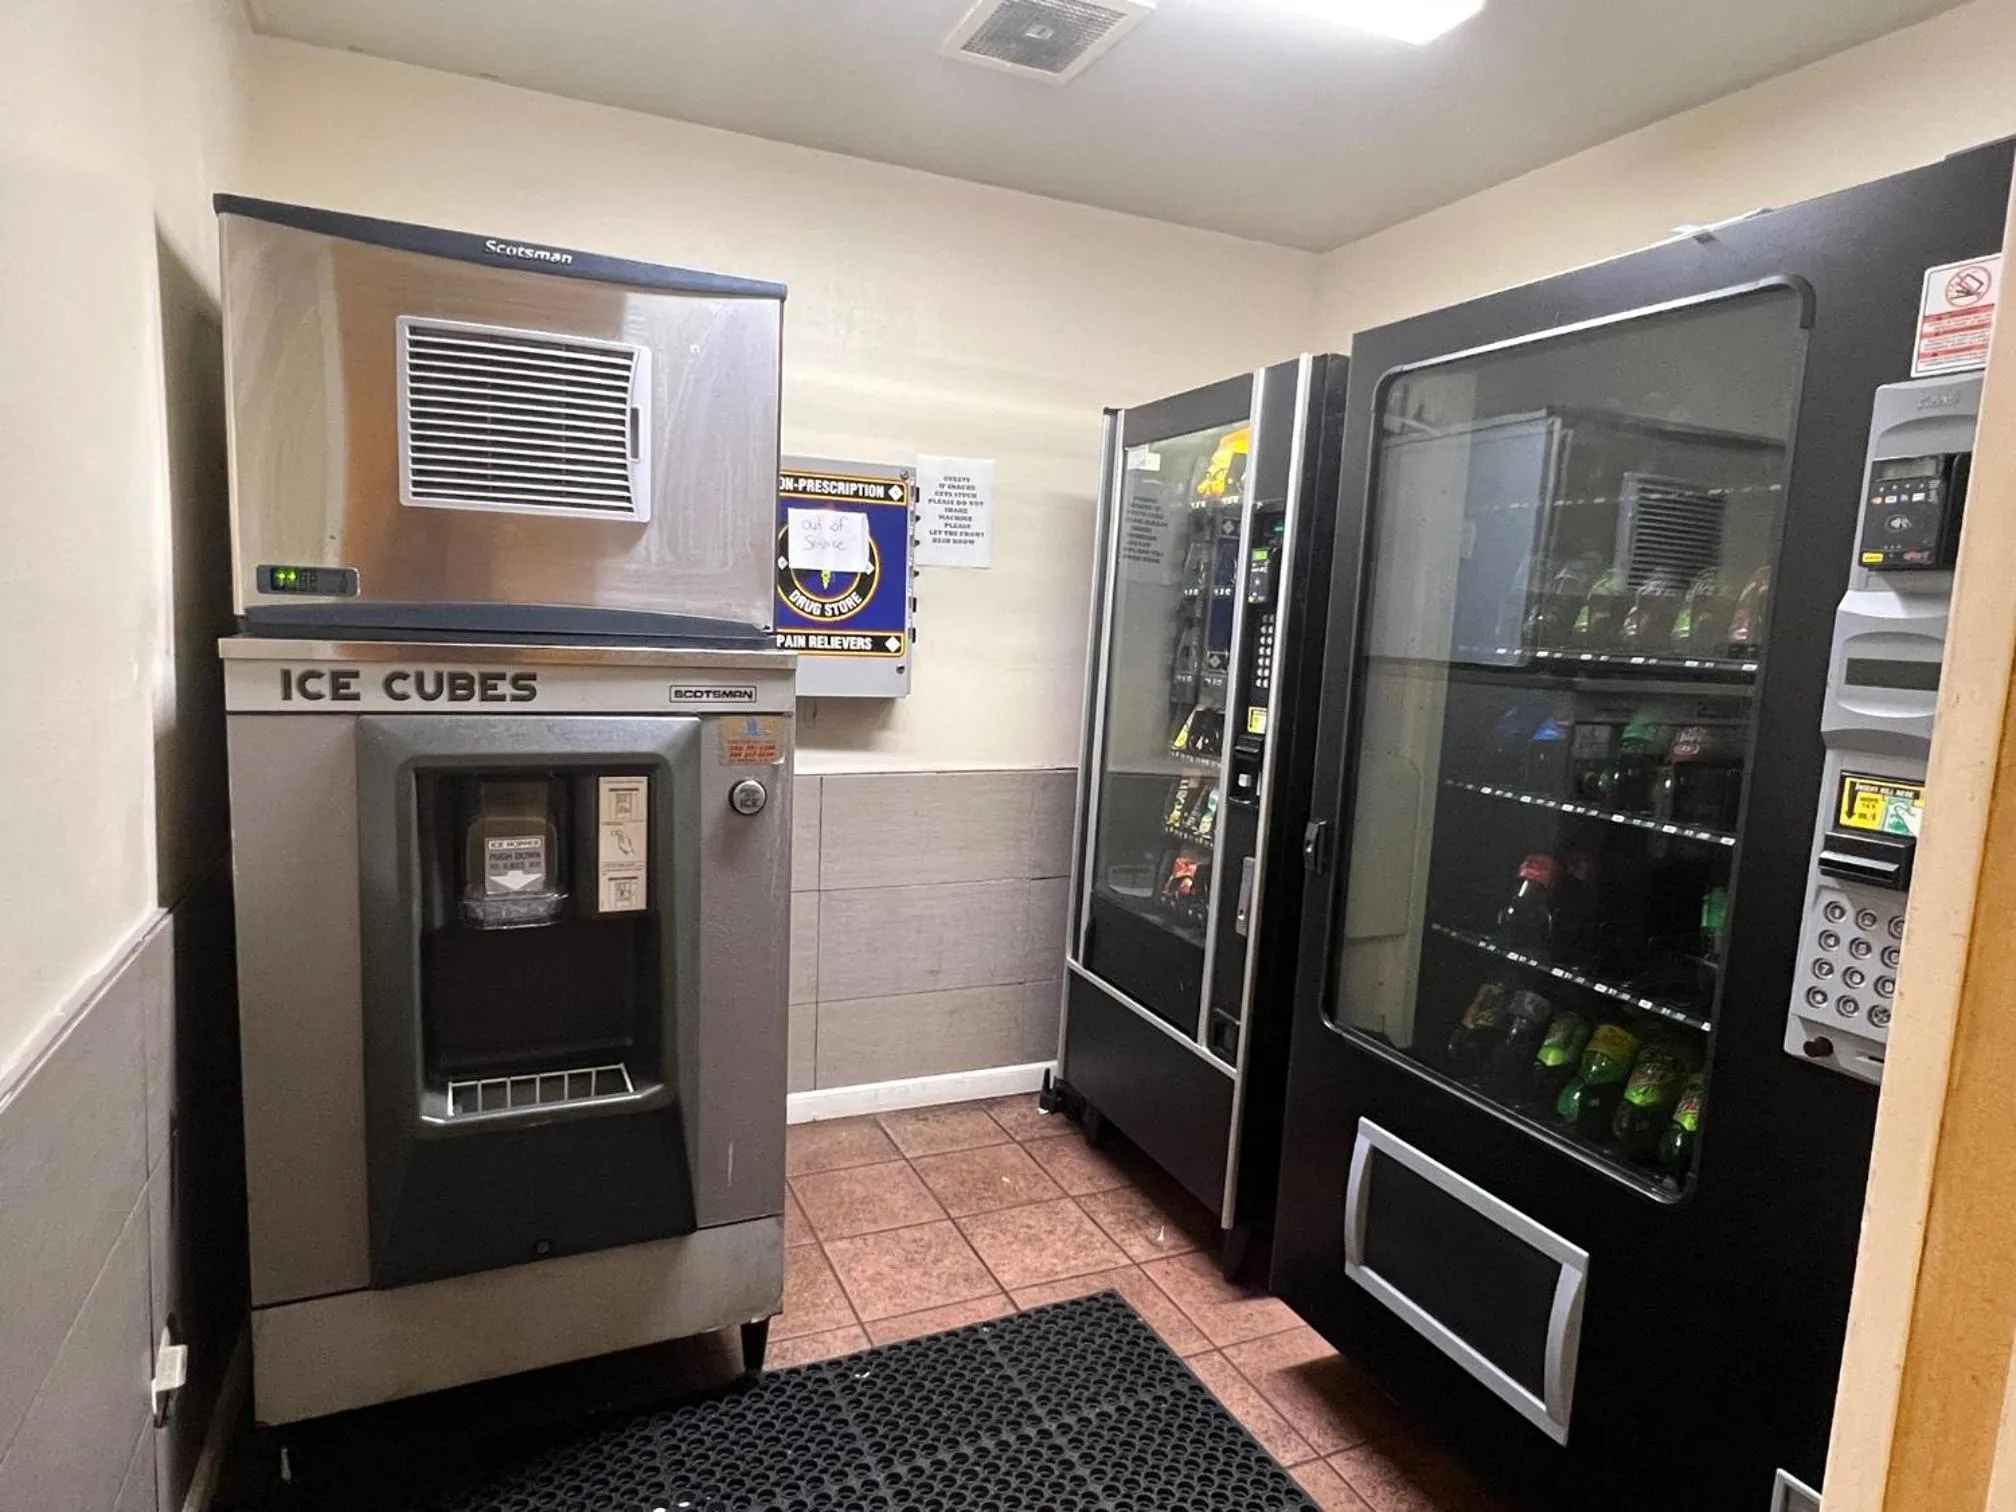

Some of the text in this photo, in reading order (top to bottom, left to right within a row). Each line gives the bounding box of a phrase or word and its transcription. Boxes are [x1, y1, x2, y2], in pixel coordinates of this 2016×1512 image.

[485, 239, 573, 265] Scotsman
[789, 589, 862, 617] DRUG STORE
[776, 634, 872, 650] PAIN RELIEVERS
[280, 668, 538, 703] ICE CUBES
[674, 689, 754, 699] SCOTSMAN
